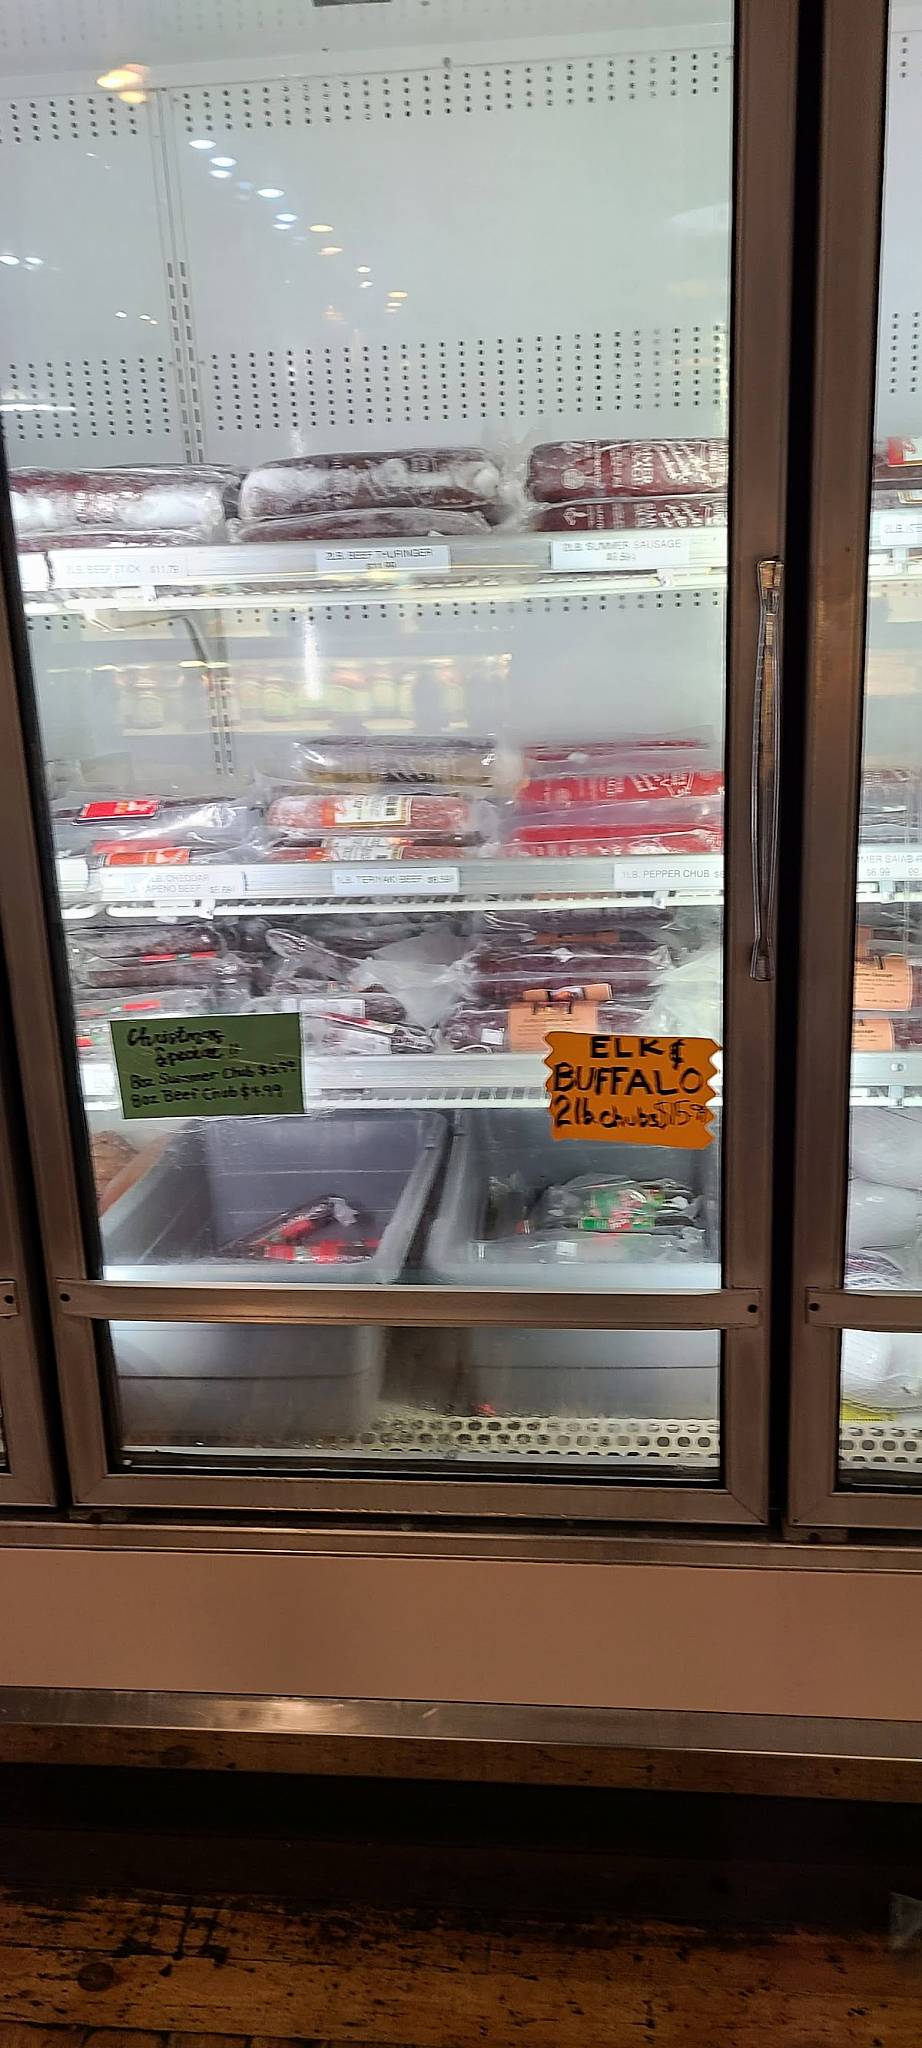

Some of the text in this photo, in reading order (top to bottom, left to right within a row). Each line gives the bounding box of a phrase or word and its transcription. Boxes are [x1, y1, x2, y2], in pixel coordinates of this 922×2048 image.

[632, 538, 681, 549] SAUSAGE
[643, 870, 681, 879] PEPPER
[682, 869, 710, 878] CHUB
[127, 1026, 225, 1047] Christmas
[590, 1035, 665, 1059] ELK
[158, 1071, 219, 1085] Summer
[552, 1062, 704, 1096] BUFFALO
[160, 1087, 200, 1103] Beef
